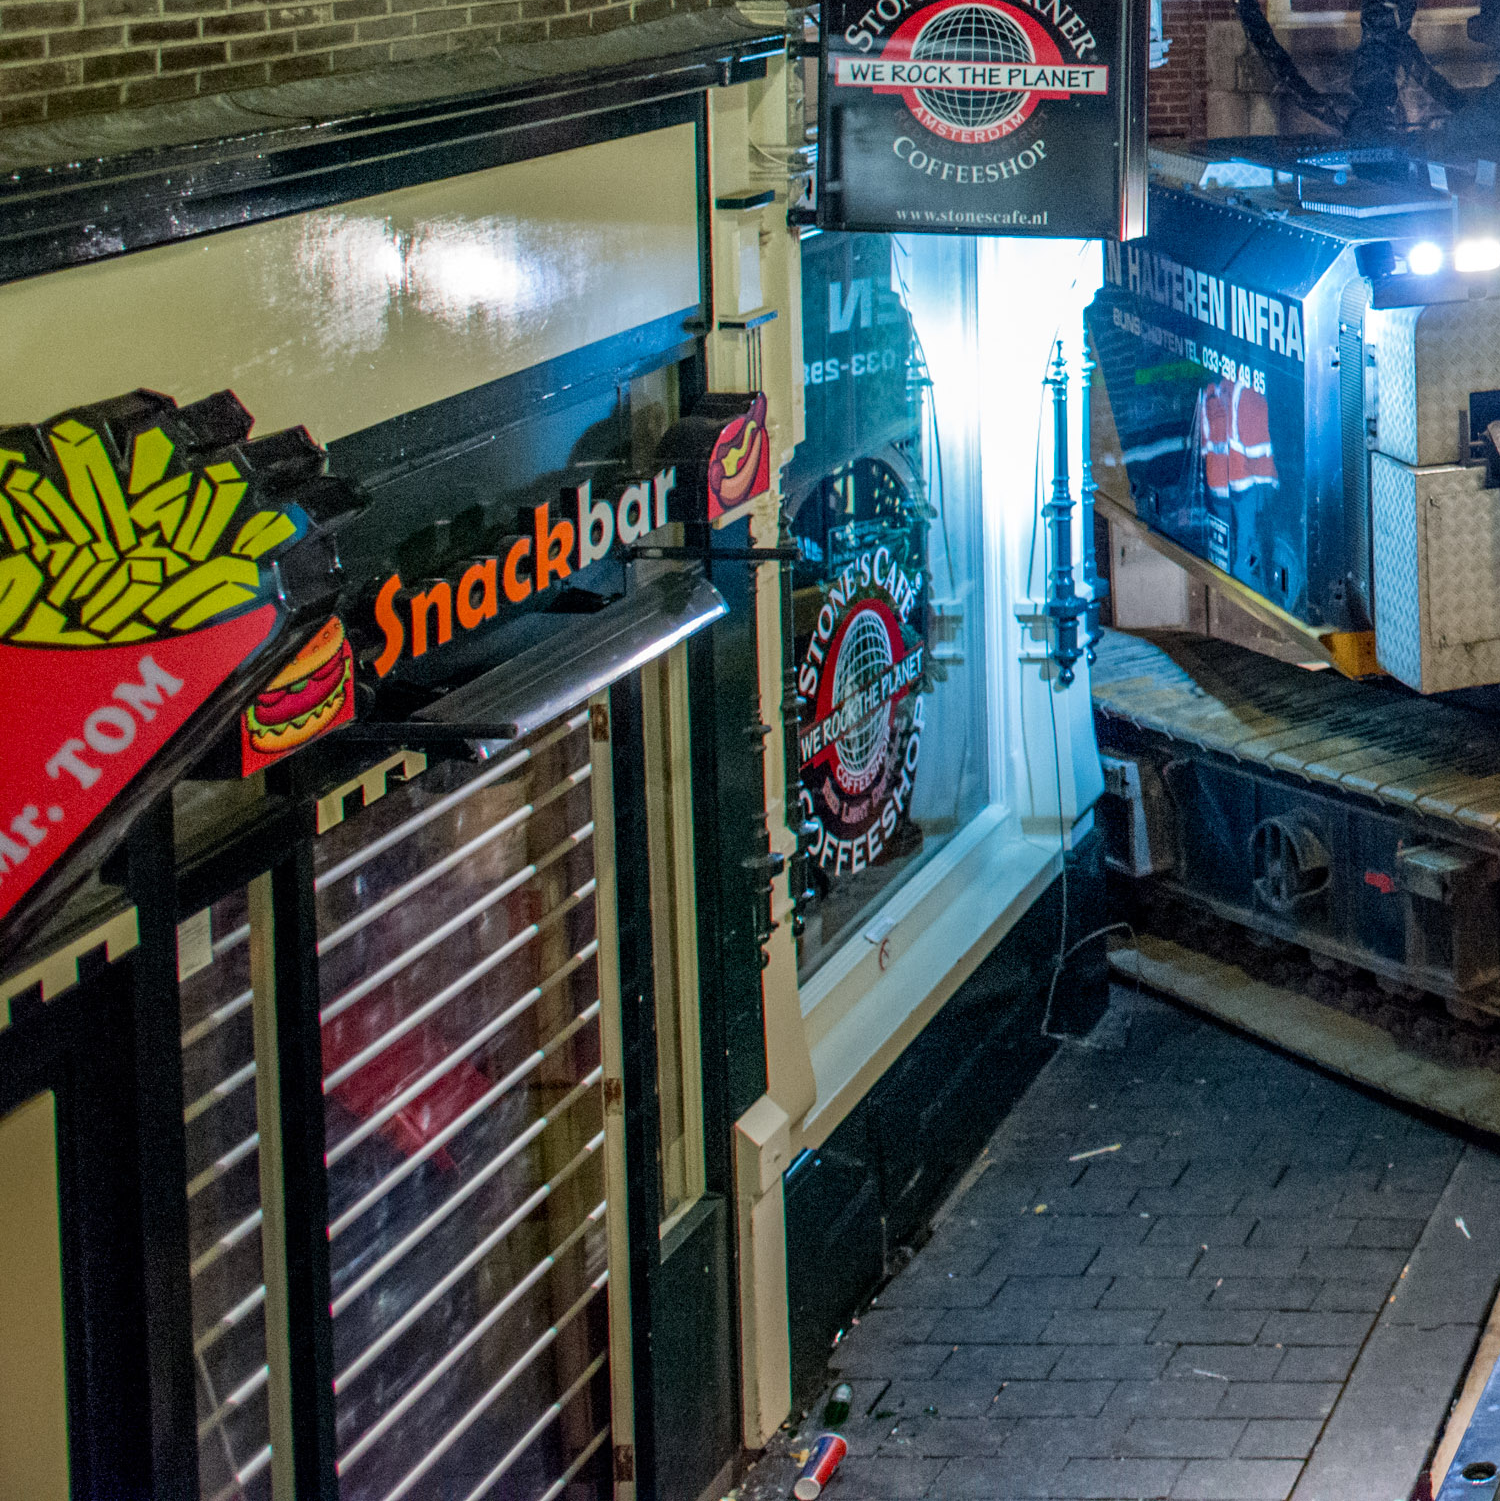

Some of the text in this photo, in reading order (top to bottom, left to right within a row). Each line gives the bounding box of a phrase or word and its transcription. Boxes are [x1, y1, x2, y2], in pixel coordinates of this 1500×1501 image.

[851, 62, 1095, 89] WE ROCK THE PLANET
[893, 135, 1048, 184] COFFEESHOP
[912, 105, 1026, 143] AMSTERDAM
[895, 209, 1049, 226] www.stonescafe.nl
[1128, 245, 1226, 331] HALTEREN
[1231, 284, 1305, 363] INFRA
[1253, 368, 1266, 396] 85
[373, 465, 677, 679] Snackbar
[798, 550, 872, 697] STONE'S
[45, 655, 185, 790] TOM
[800, 726, 822, 763] WE
[856, 681, 880, 718] THE
[880, 646, 924, 701] PLANET
